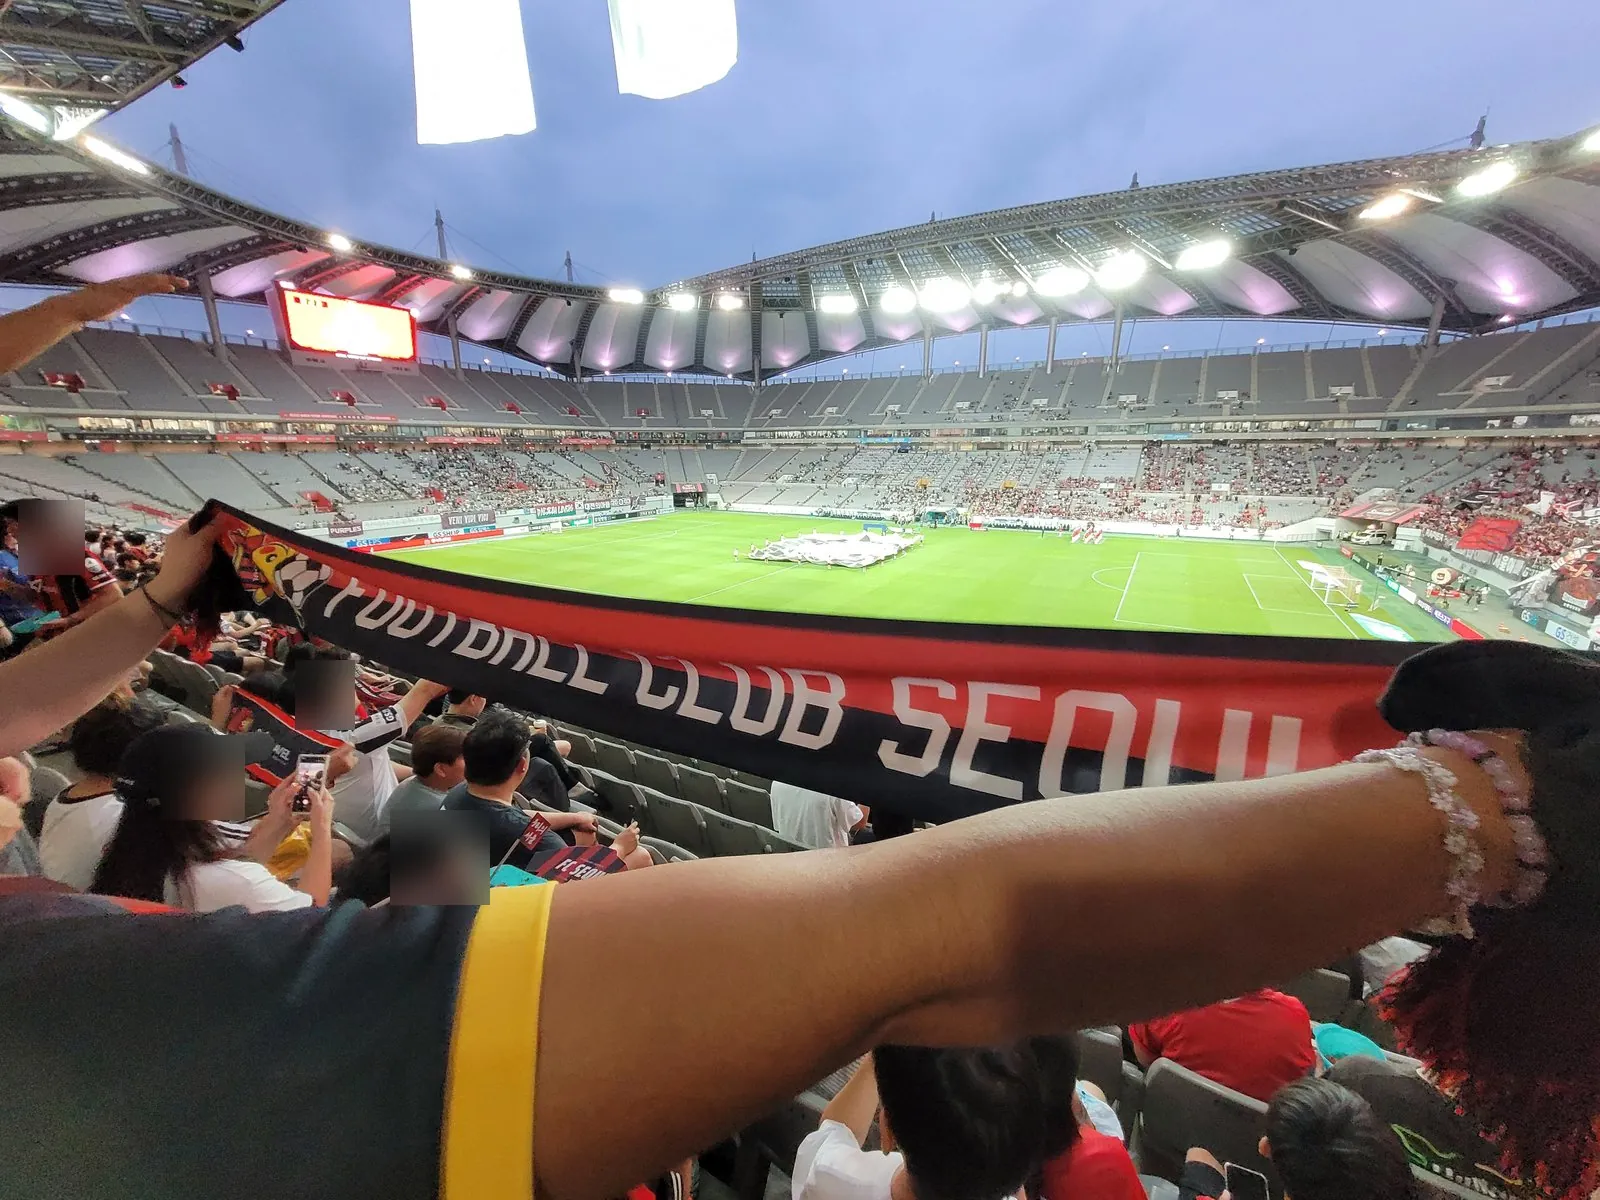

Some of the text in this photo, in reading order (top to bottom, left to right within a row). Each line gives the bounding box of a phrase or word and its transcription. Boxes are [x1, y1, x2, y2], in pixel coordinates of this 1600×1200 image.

[330, 525, 362, 534] PURPLES
[620, 649, 846, 750] CLUB
[555, 858, 607, 881] FC SEO
